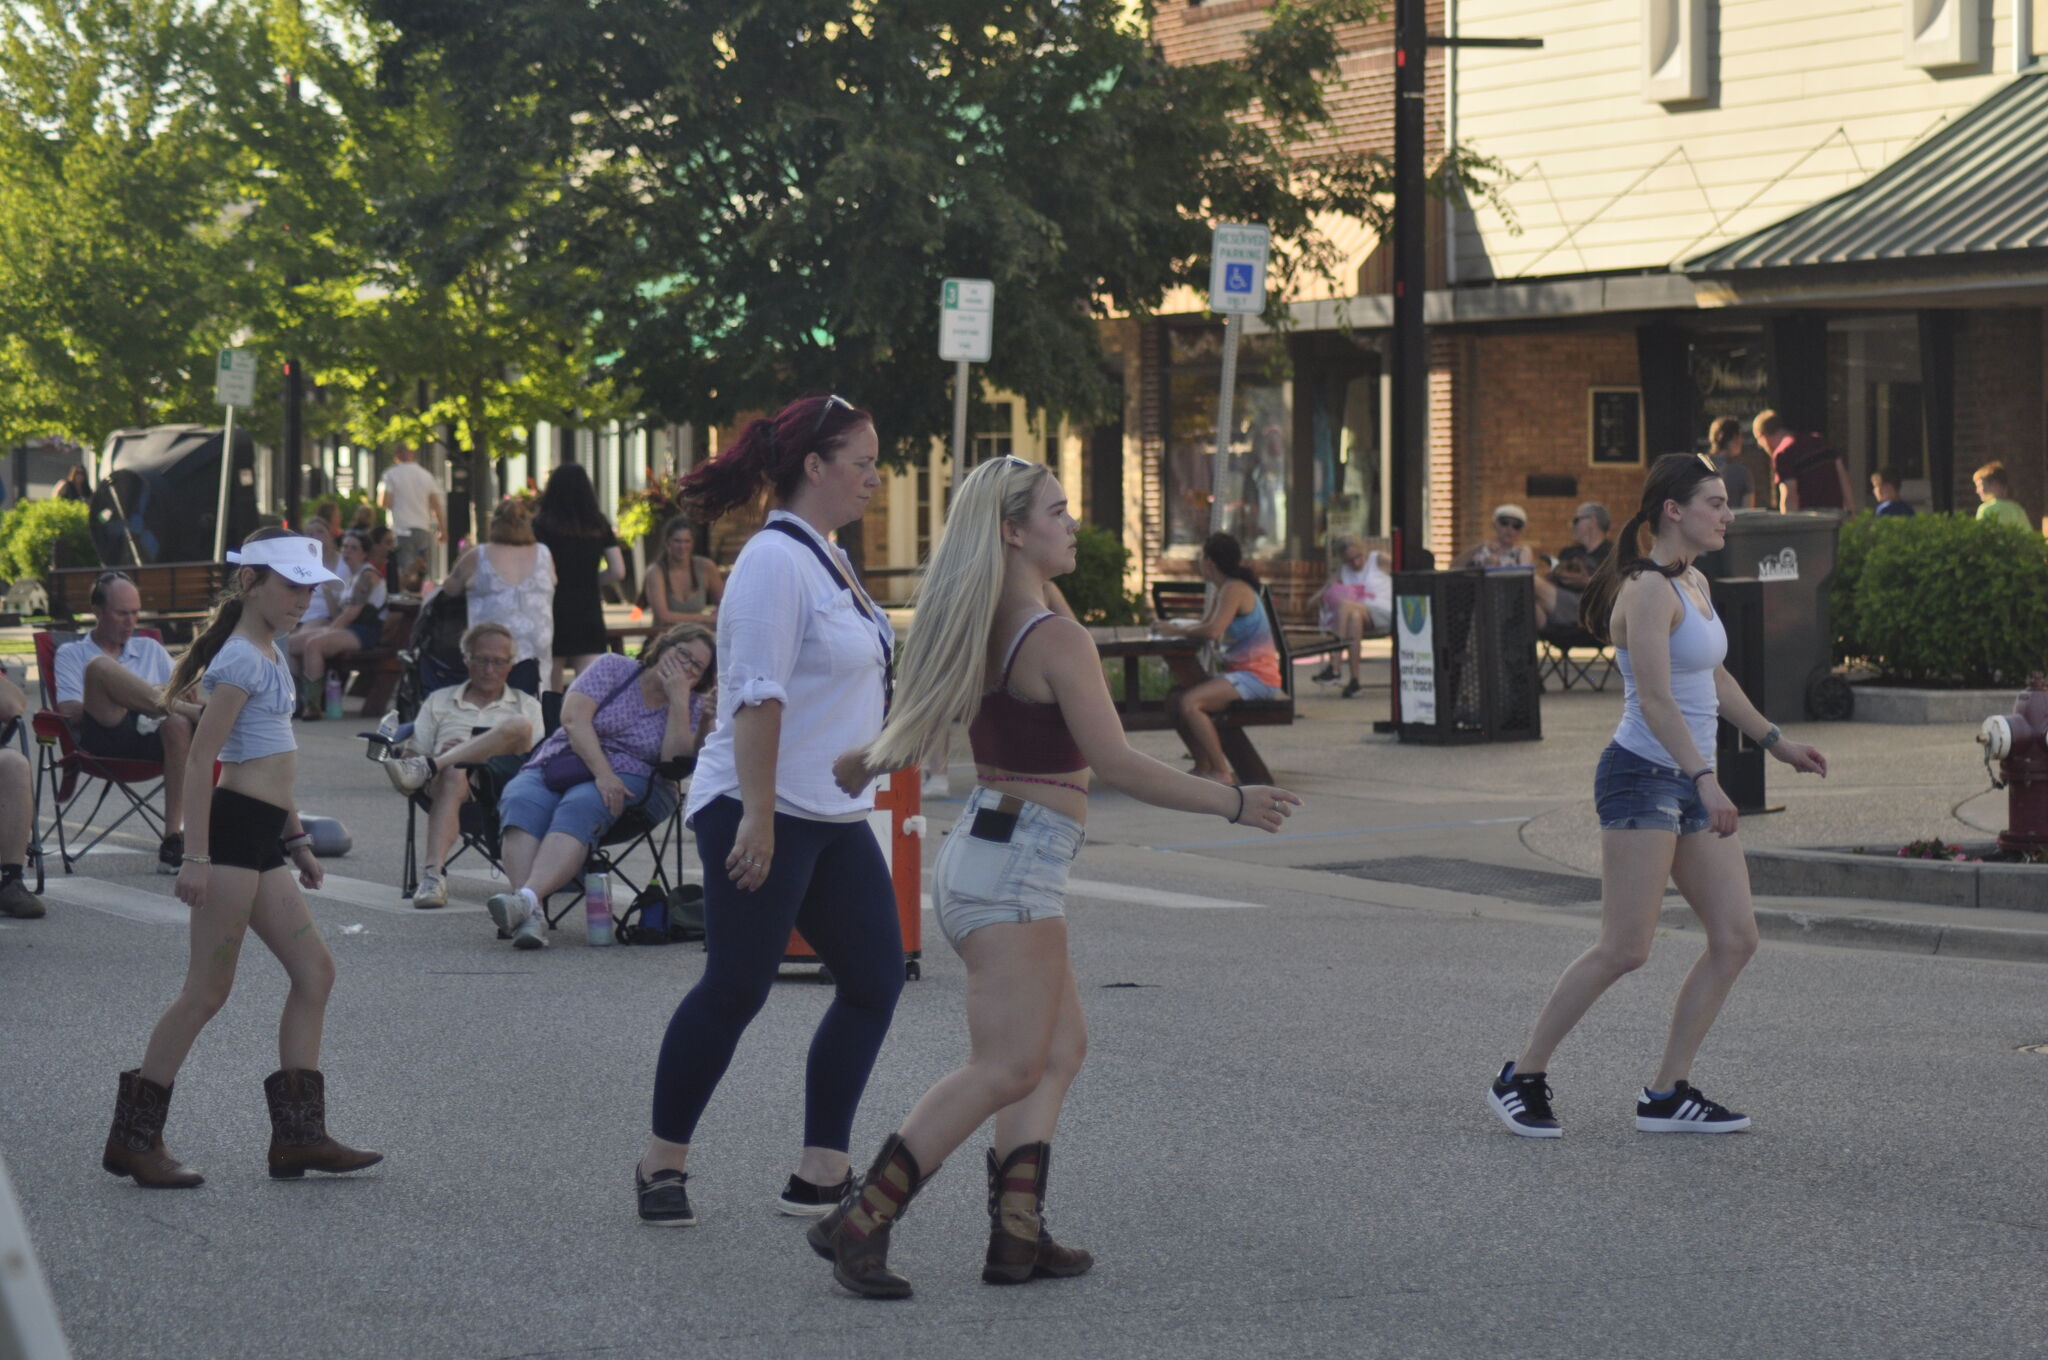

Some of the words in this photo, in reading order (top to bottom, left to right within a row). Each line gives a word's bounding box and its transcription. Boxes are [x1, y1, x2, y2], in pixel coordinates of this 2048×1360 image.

[1217, 232, 1266, 245] RESERVED
[1220, 247, 1261, 260] PARKING
[1401, 664, 1414, 675] and
[1413, 679, 1432, 692] trace
